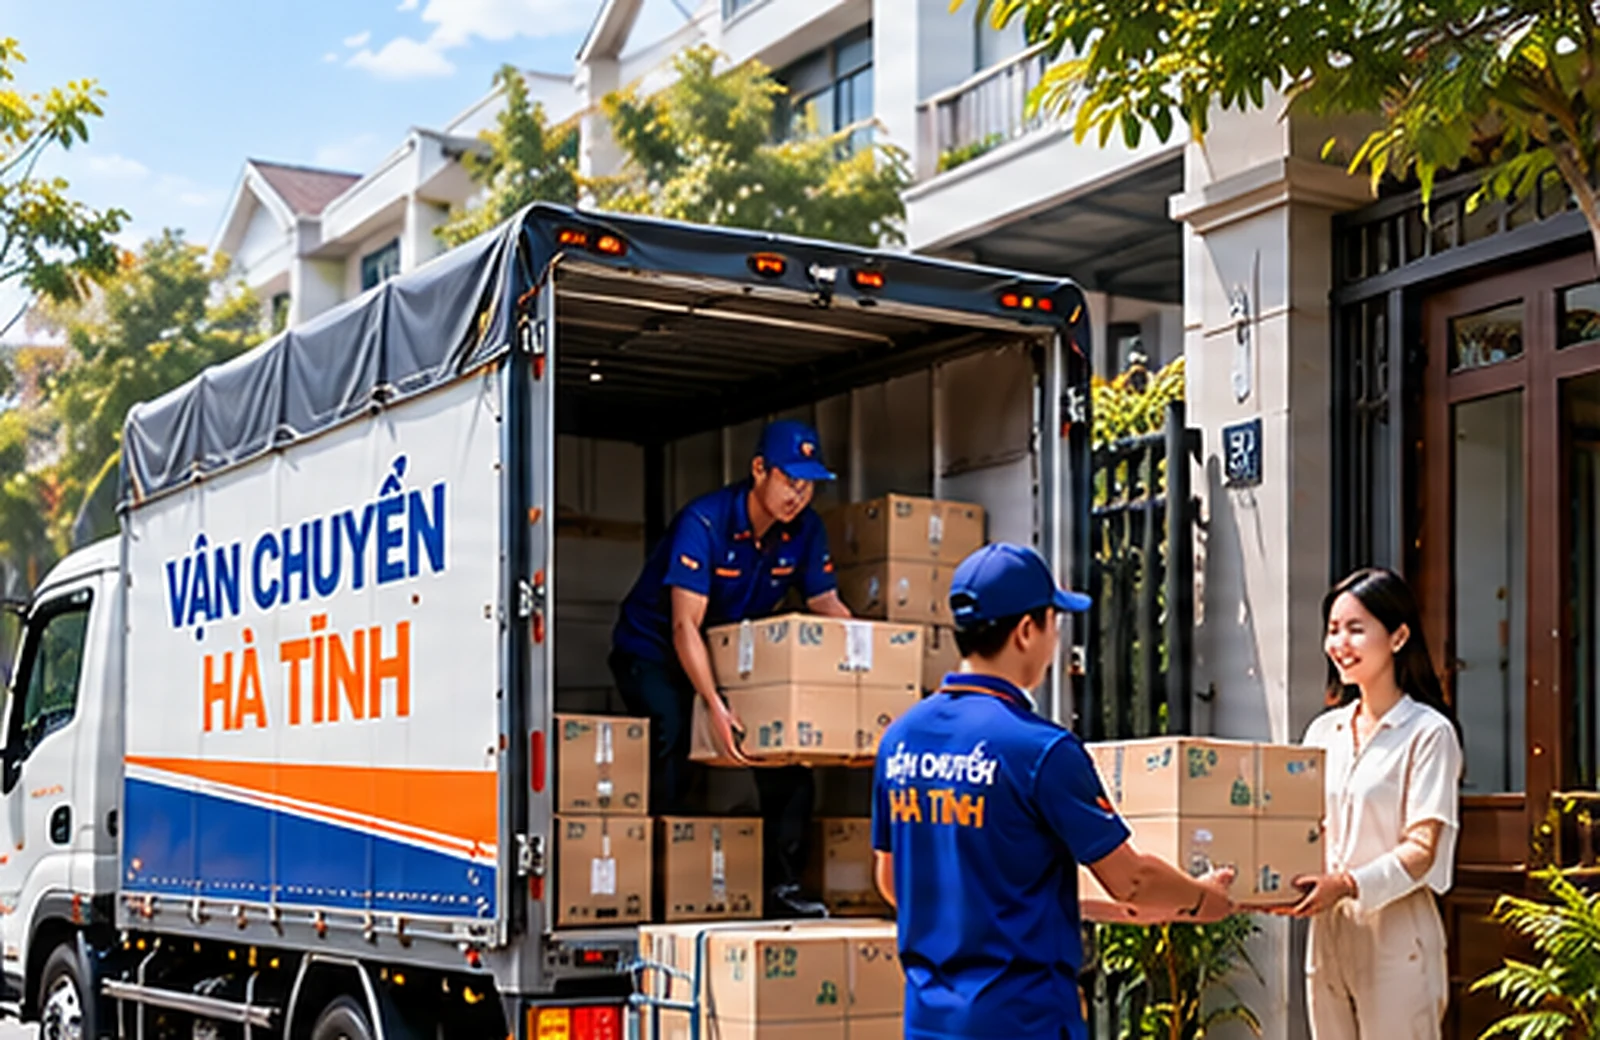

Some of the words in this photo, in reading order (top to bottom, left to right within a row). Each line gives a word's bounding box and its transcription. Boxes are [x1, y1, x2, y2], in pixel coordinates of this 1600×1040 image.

[166, 534, 241, 640] VẬN
[252, 455, 446, 609] CHUYỂN
[203, 628, 268, 732] HÀ
[280, 613, 411, 726] TĨNH
